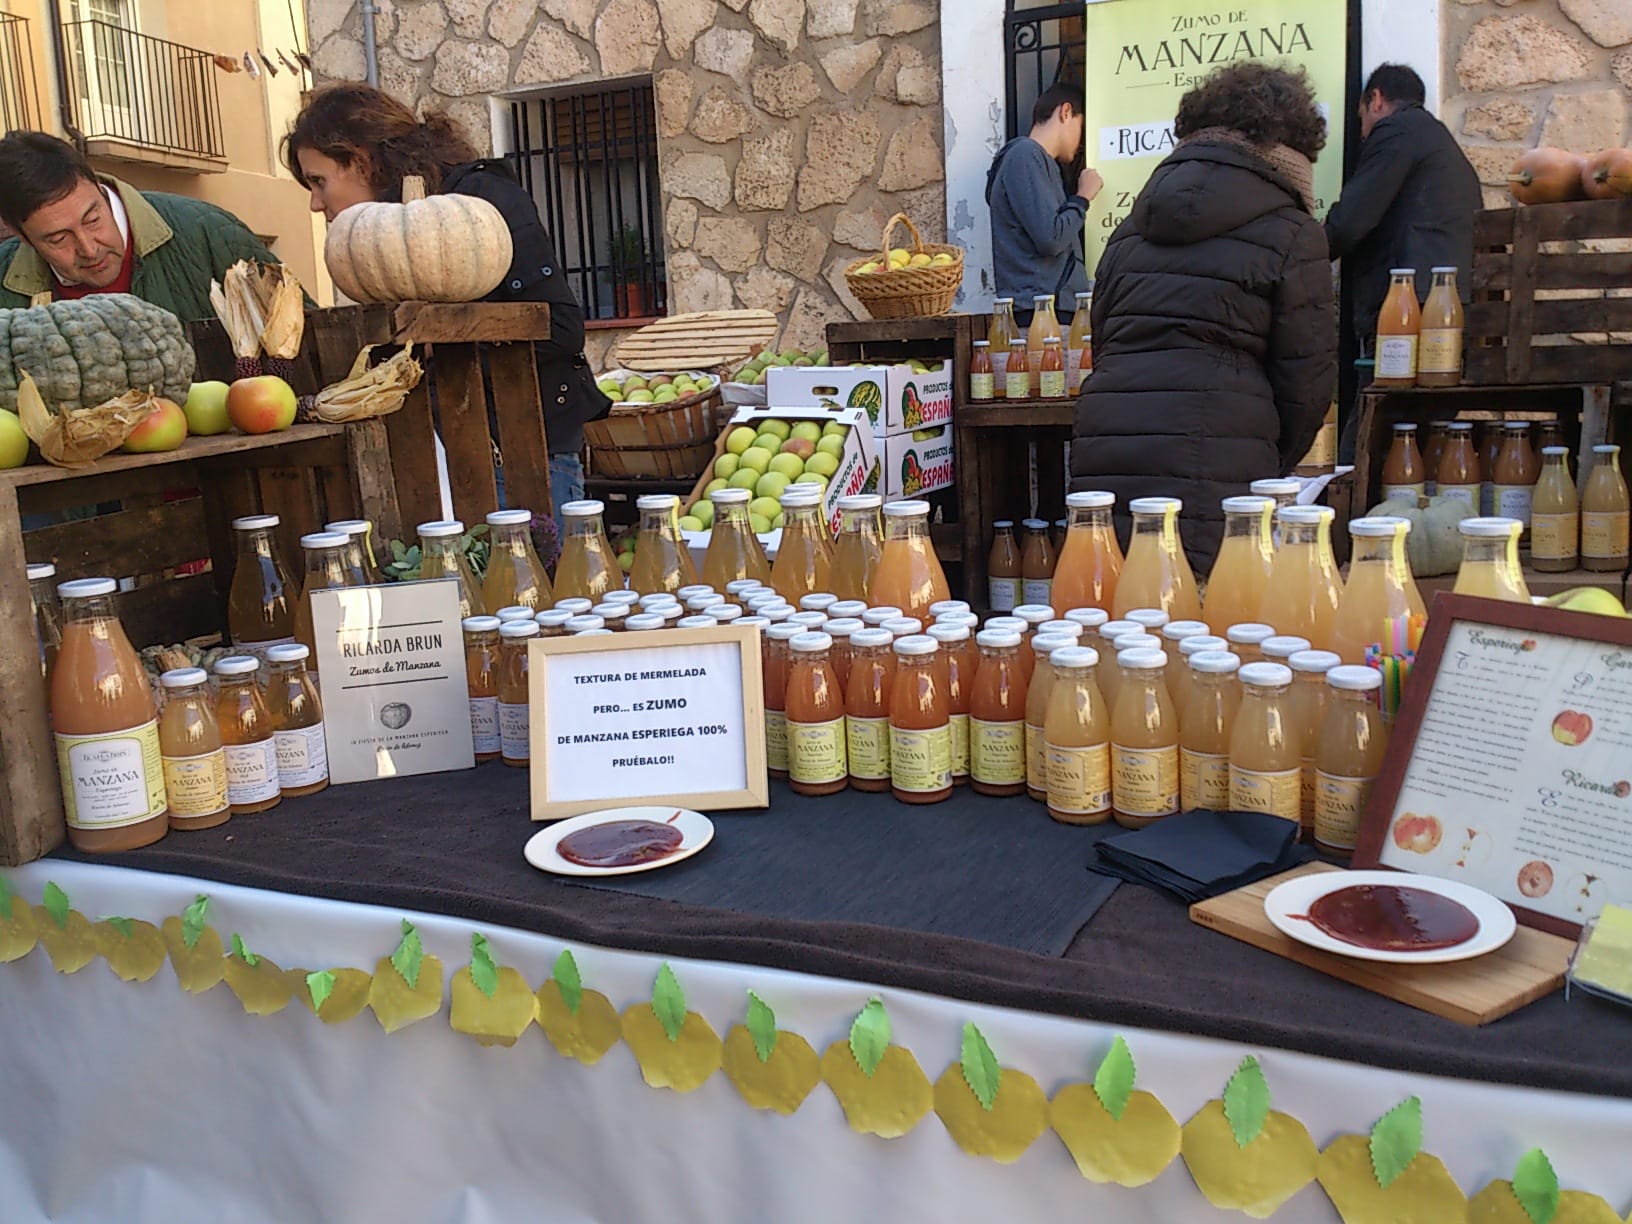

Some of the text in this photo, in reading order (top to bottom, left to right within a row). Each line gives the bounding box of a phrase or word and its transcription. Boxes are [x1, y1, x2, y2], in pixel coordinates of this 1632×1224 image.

[1114, 23, 1313, 75] MANZANA
[923, 382, 948, 394] PRODUCTOS
[923, 447, 948, 461] PRODUCTOS
[344, 634, 442, 658] RICARDA BRUN
[350, 660, 441, 676] Zumos de Manzana
[574, 667, 707, 685] TEXTURA DE MERMELADA
[593, 698, 687, 715] PERO... ES ZUMO
[557, 724, 728, 745] DE MANZANA ESPERIEGA 100%
[612, 755, 675, 768] PRUÉBALO!!
[77, 770, 139, 787] MANZANA
